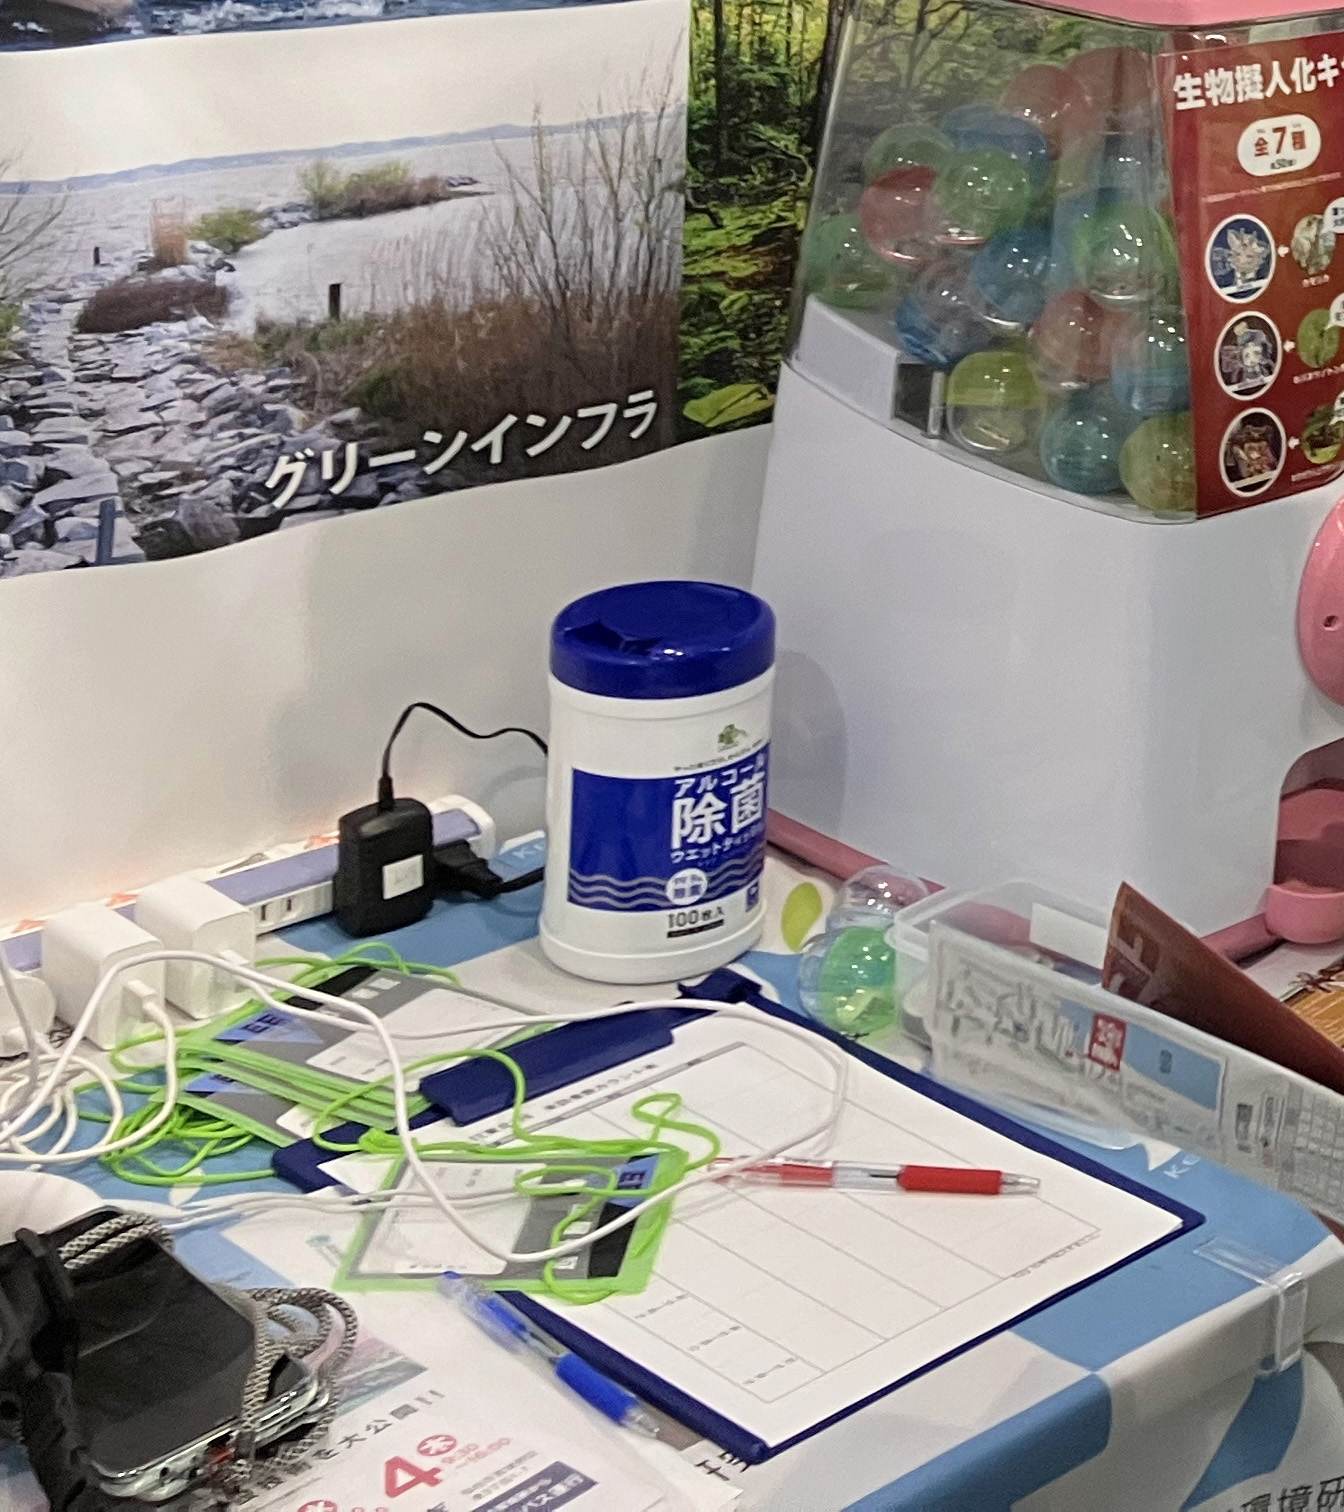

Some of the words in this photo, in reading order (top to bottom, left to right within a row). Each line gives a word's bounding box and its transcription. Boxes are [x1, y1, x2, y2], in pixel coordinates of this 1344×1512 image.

[267, 390, 657, 508] グリーンインフラ
[671, 771, 765, 850] 除菌
[385, 1455, 443, 1498] 4
